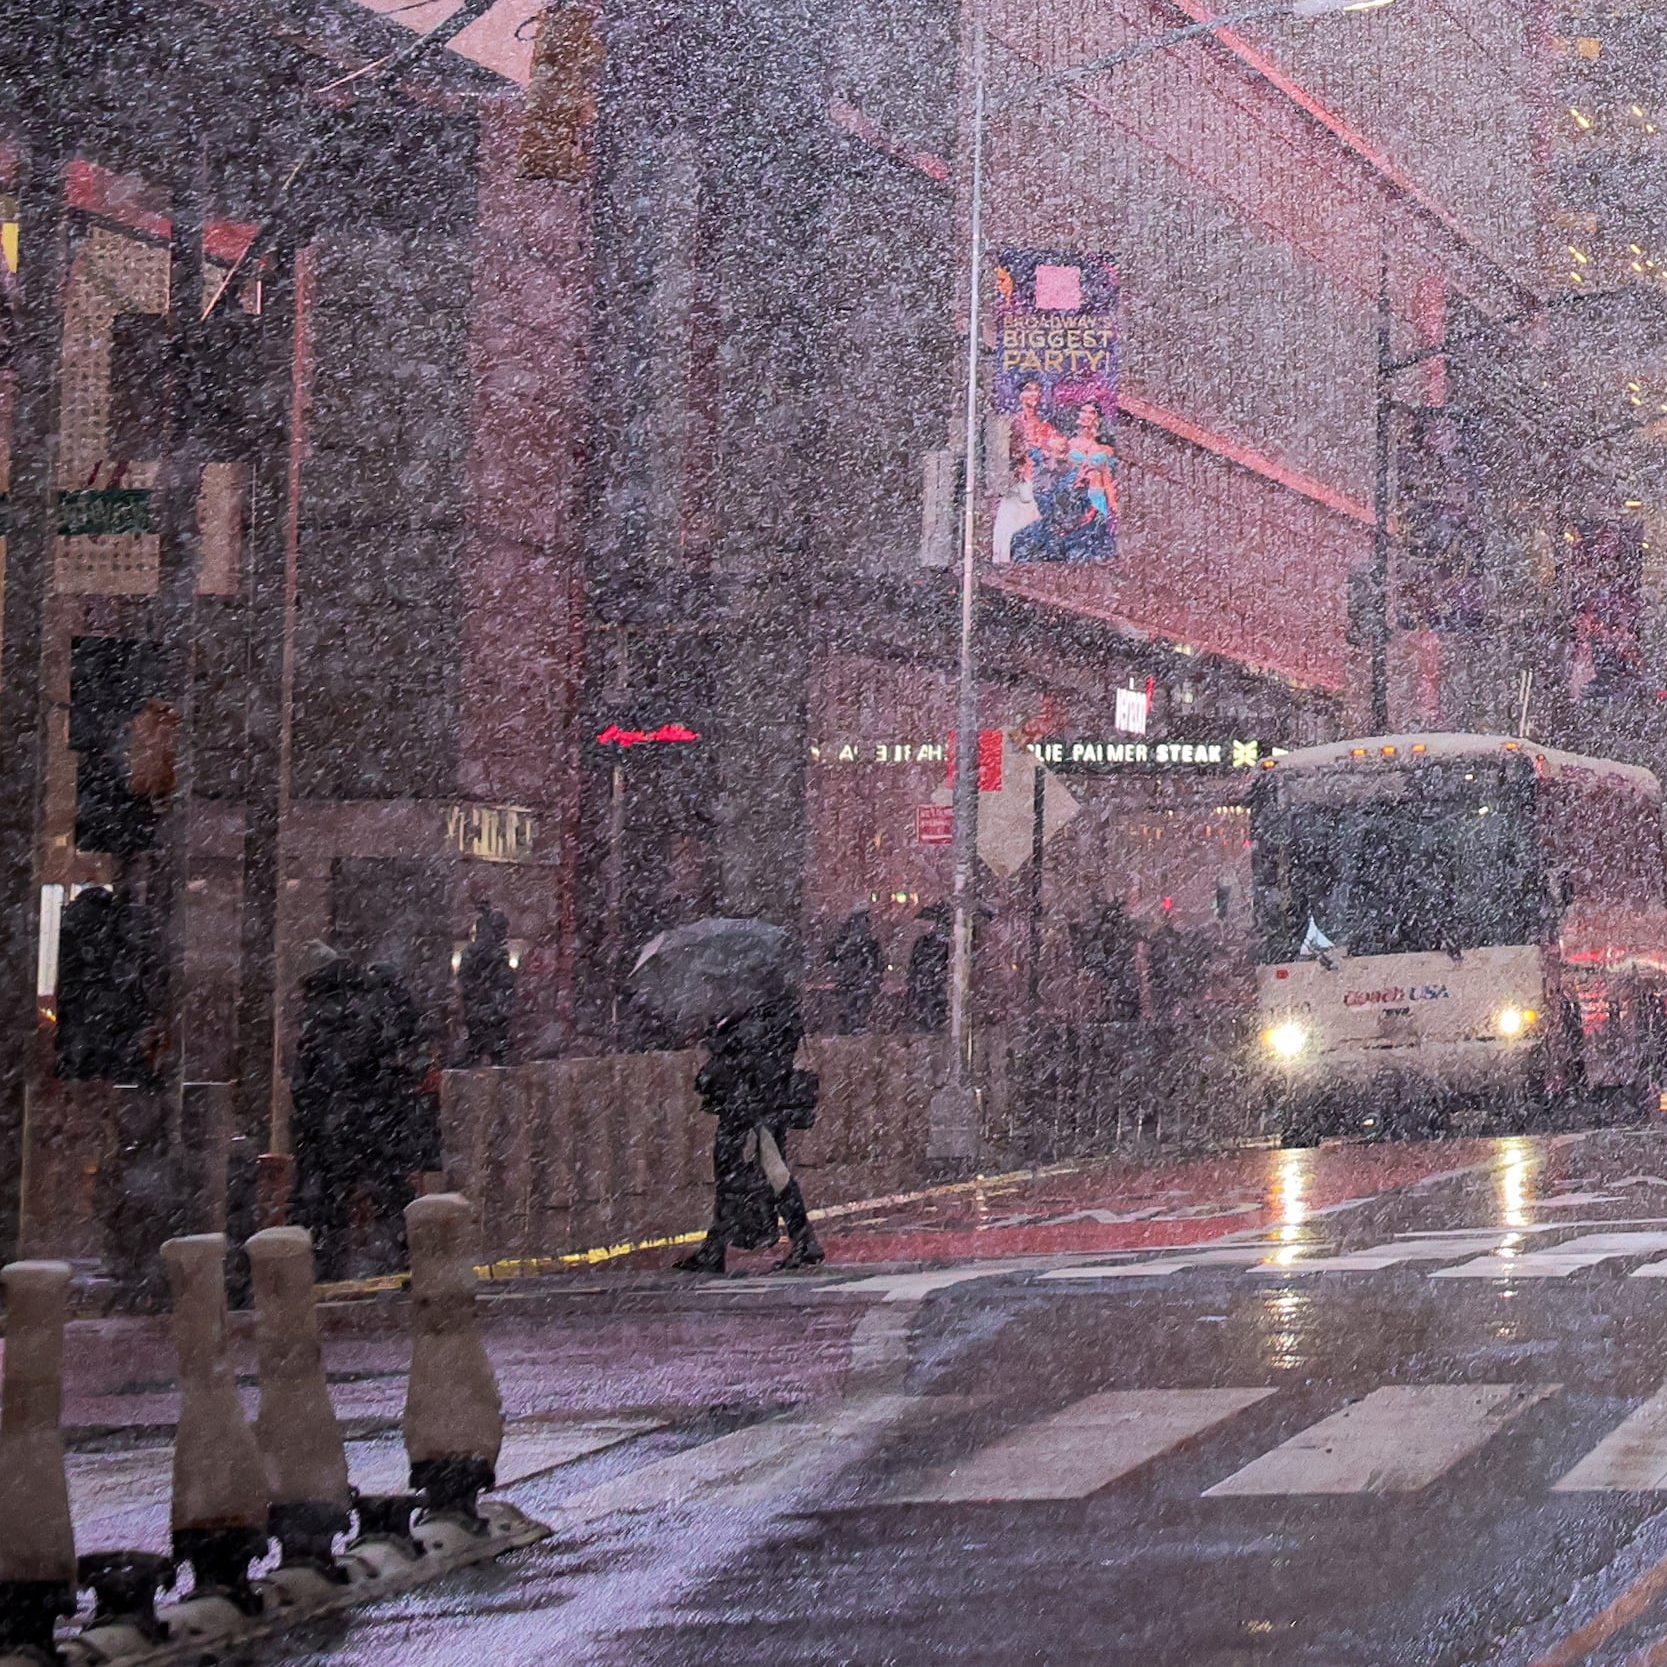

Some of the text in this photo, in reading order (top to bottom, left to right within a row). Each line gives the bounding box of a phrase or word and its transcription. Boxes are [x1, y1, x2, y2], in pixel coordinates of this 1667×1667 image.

[1003, 329, 1114, 348] BIGGEST
[1003, 349, 1110, 373] PARTY!
[1071, 743, 1149, 763] PALMER
[1155, 744, 1222, 764] STEAK
